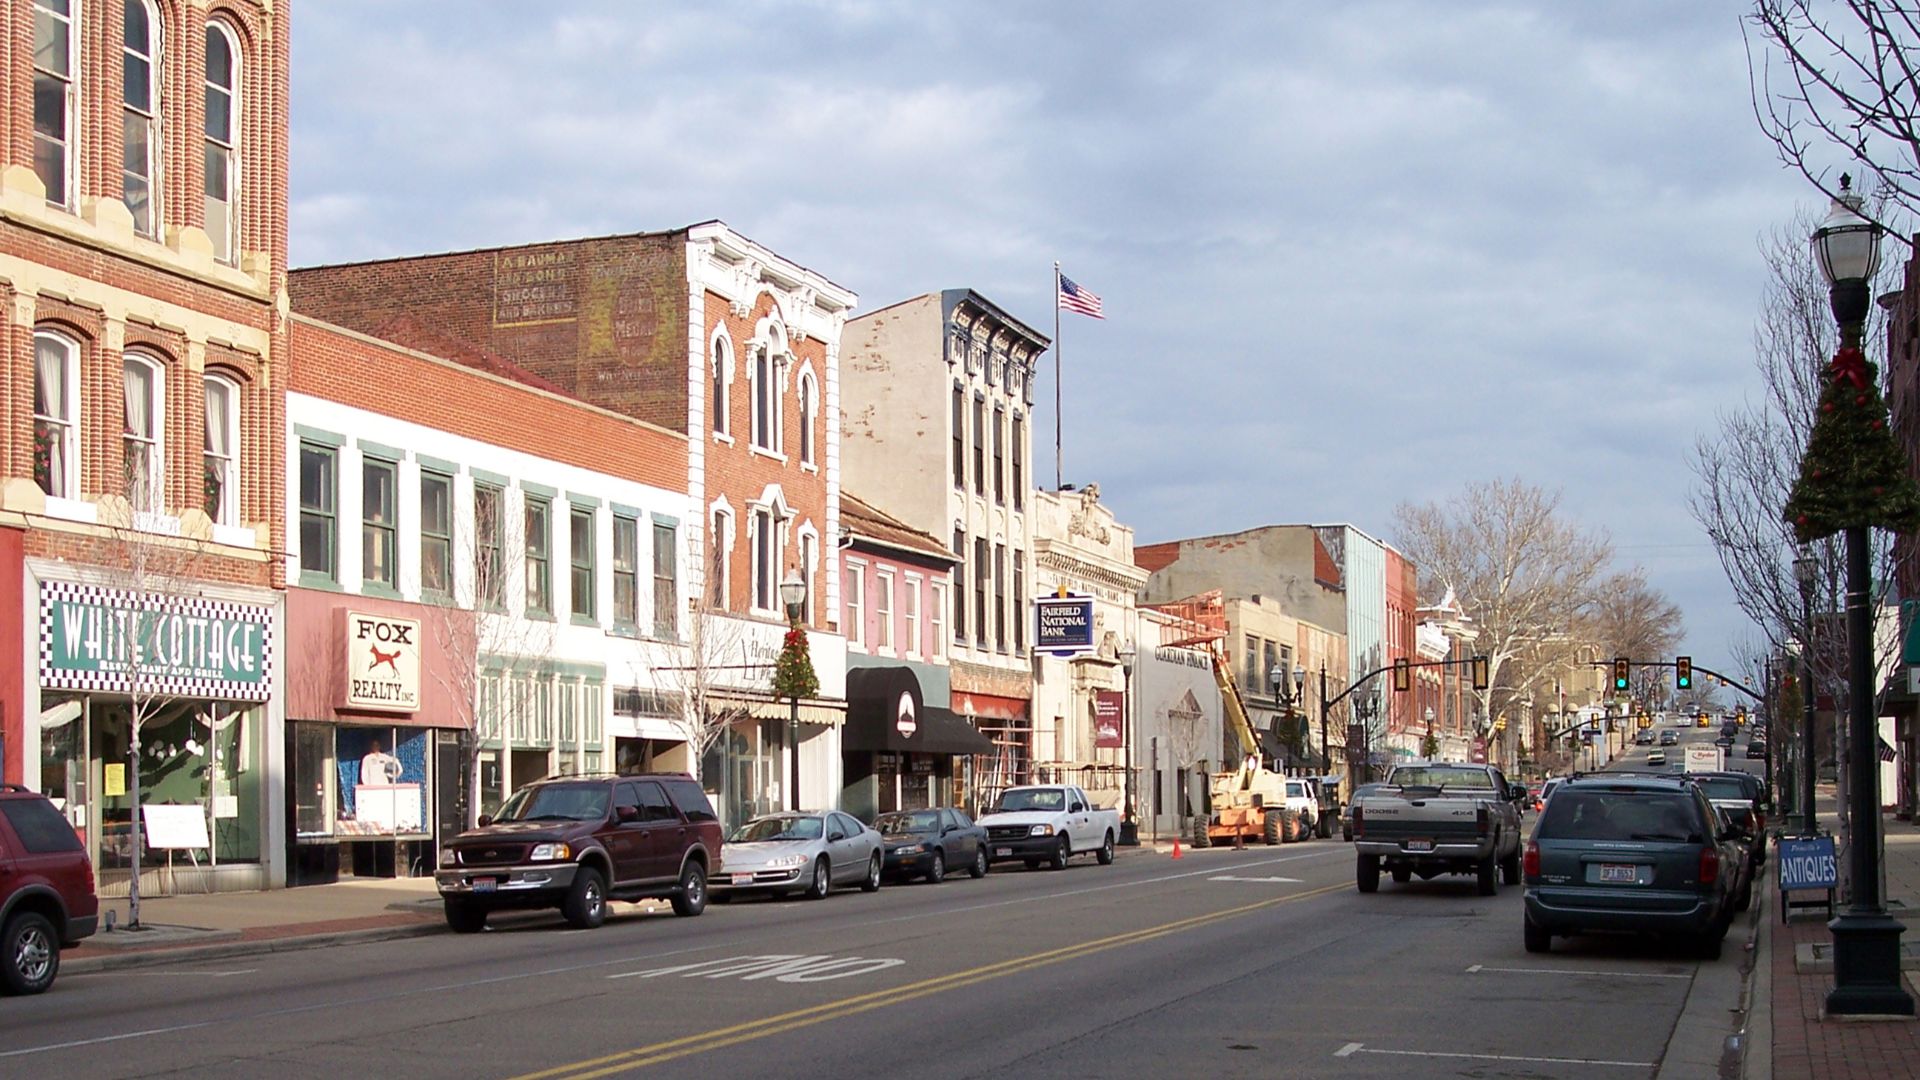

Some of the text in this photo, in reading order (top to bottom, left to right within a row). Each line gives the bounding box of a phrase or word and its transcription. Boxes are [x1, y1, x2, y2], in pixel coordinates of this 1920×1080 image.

[1041, 606, 1081, 616] FAIRFIELD
[1041, 616, 1087, 626] NATIONAL
[62, 604, 255, 672] WHITE COTTAGE
[357, 619, 412, 645] FOX
[1041, 626, 1065, 636] BANK
[1155, 645, 1185, 665] GUARDIAN
[100, 660, 224, 680] RESTRANT AND GRILL
[353, 679, 402, 701] REALTY
[1781, 855, 1836, 884] ANTIQUES
